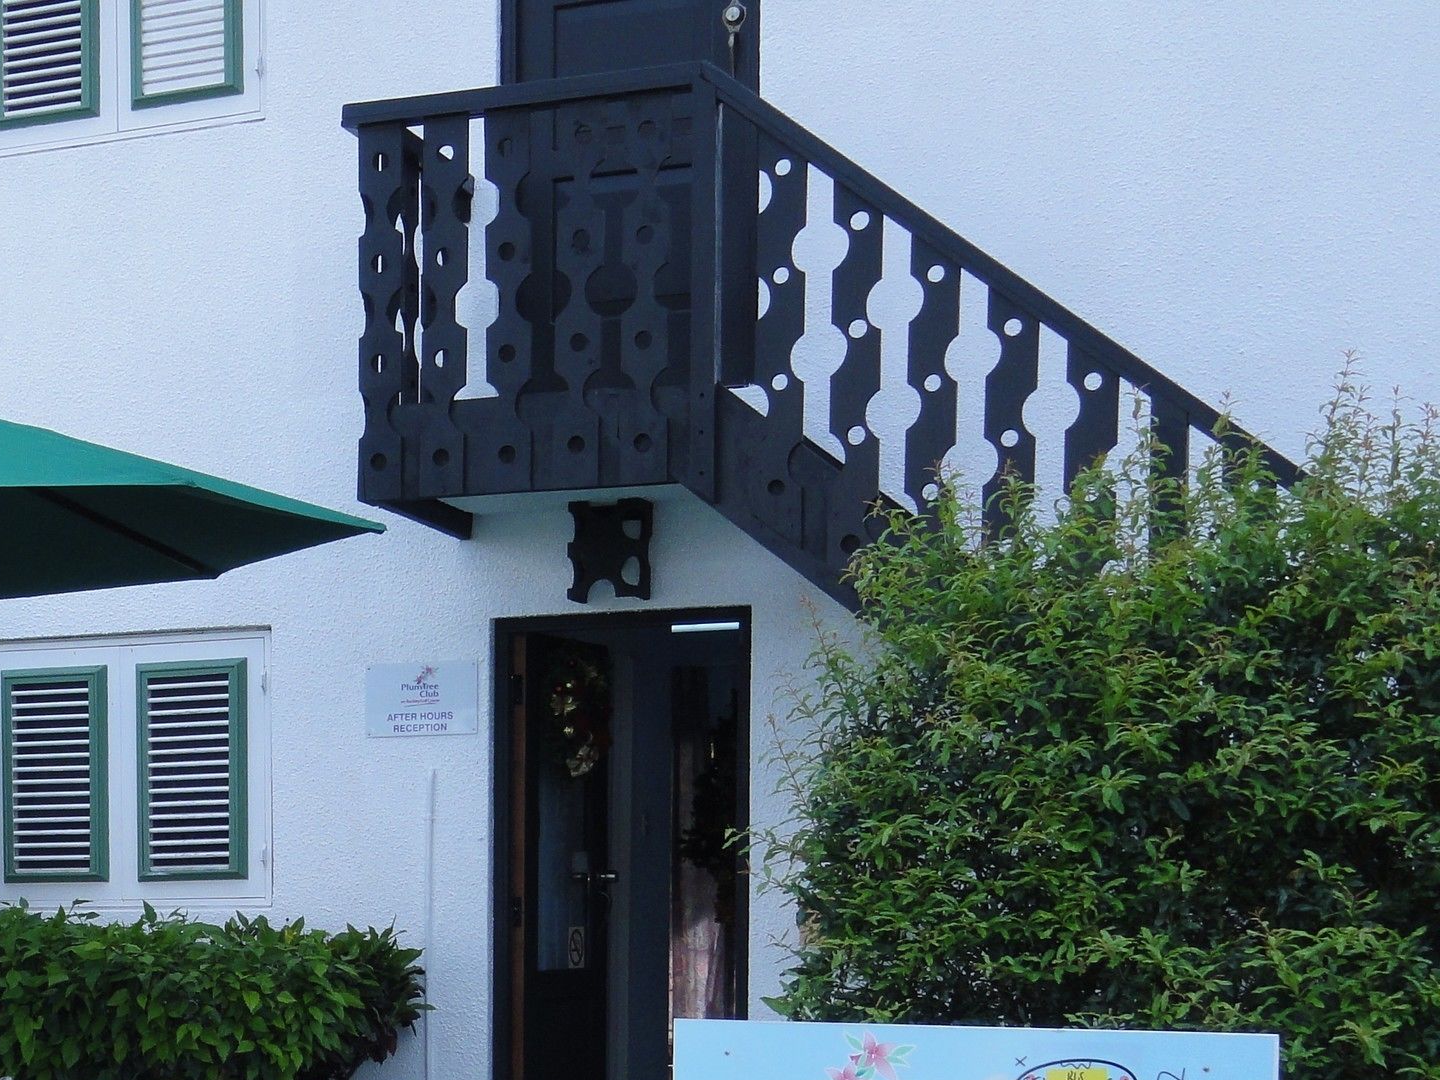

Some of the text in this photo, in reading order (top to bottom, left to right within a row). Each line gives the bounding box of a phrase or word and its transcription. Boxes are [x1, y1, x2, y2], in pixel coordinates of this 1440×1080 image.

[419, 690, 439, 698] Club
[387, 711, 453, 721] AFTER HOURS
[393, 723, 447, 733] RECEPTION
